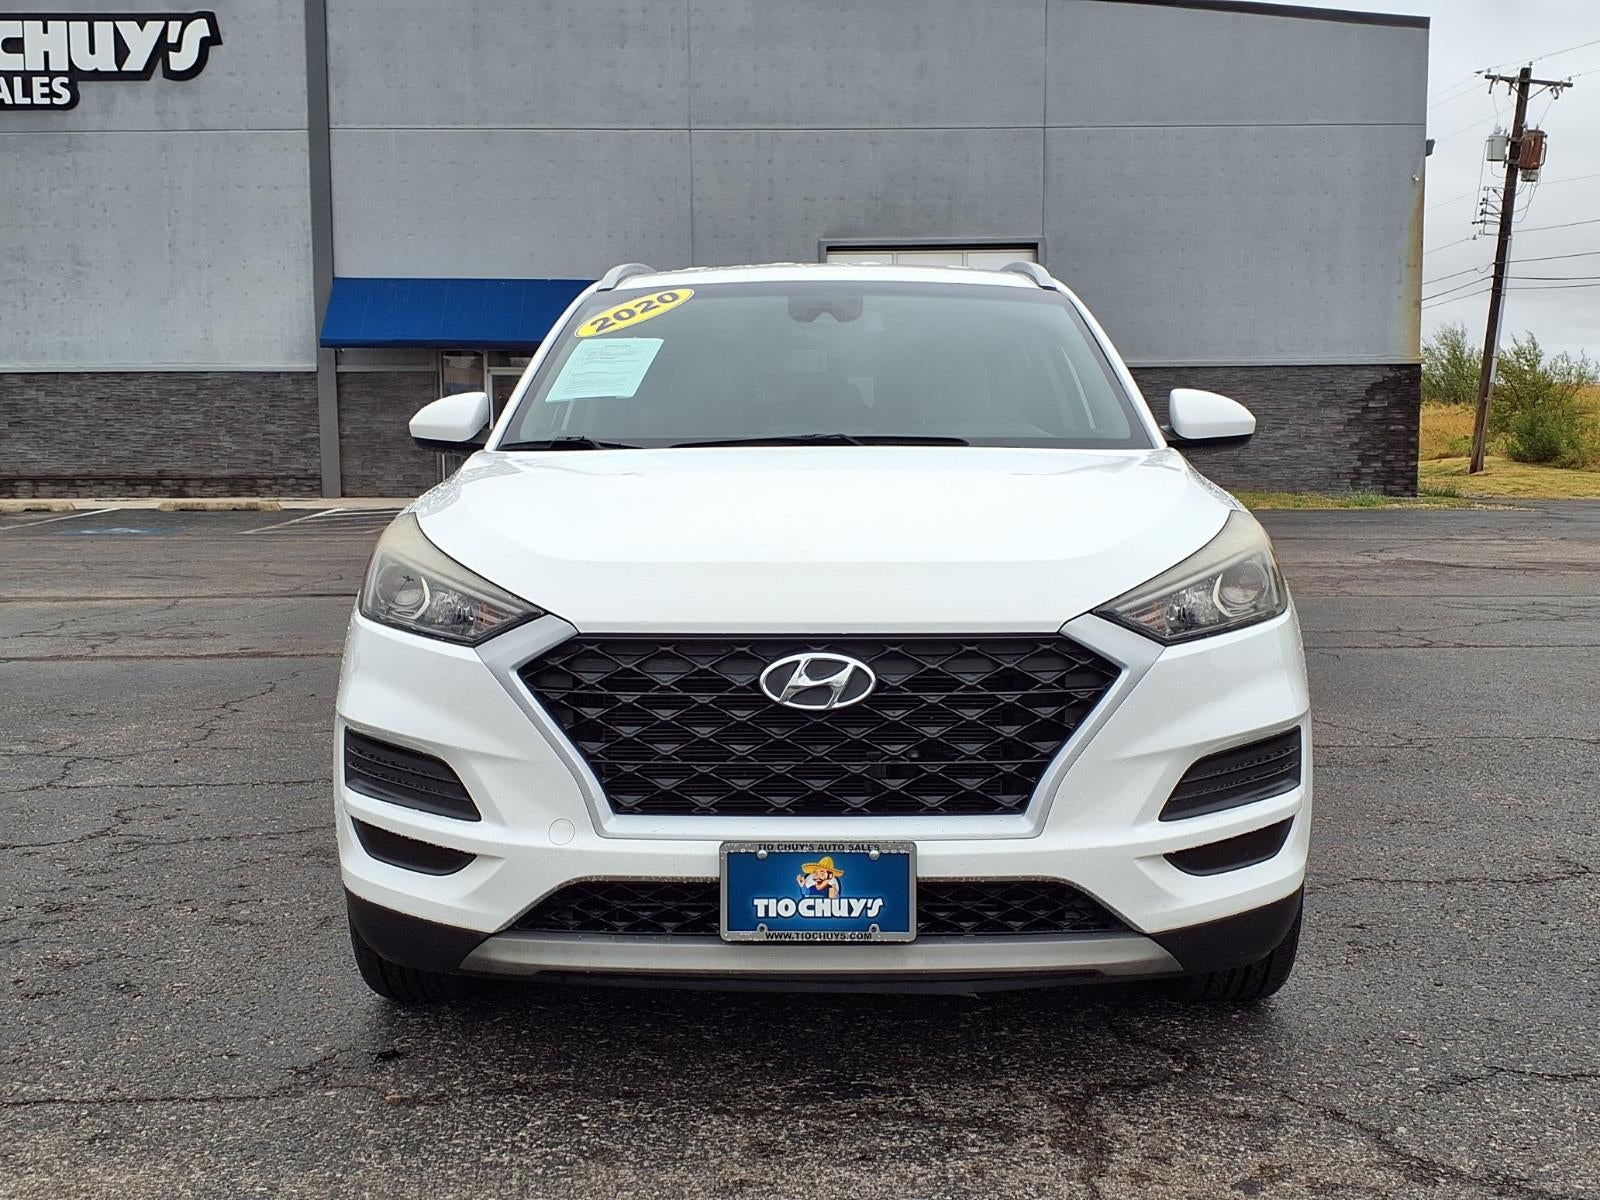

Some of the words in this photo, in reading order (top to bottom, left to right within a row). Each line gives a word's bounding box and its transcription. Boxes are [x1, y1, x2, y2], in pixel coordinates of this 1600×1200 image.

[0, 18, 211, 72] CHUY'S
[590, 291, 679, 333] 2020
[777, 843, 815, 851] CHUY'S
[817, 843, 845, 851] AUTO
[848, 843, 880, 851] SALES
[765, 932, 873, 940] WWW.TIOCHUYS.COM
